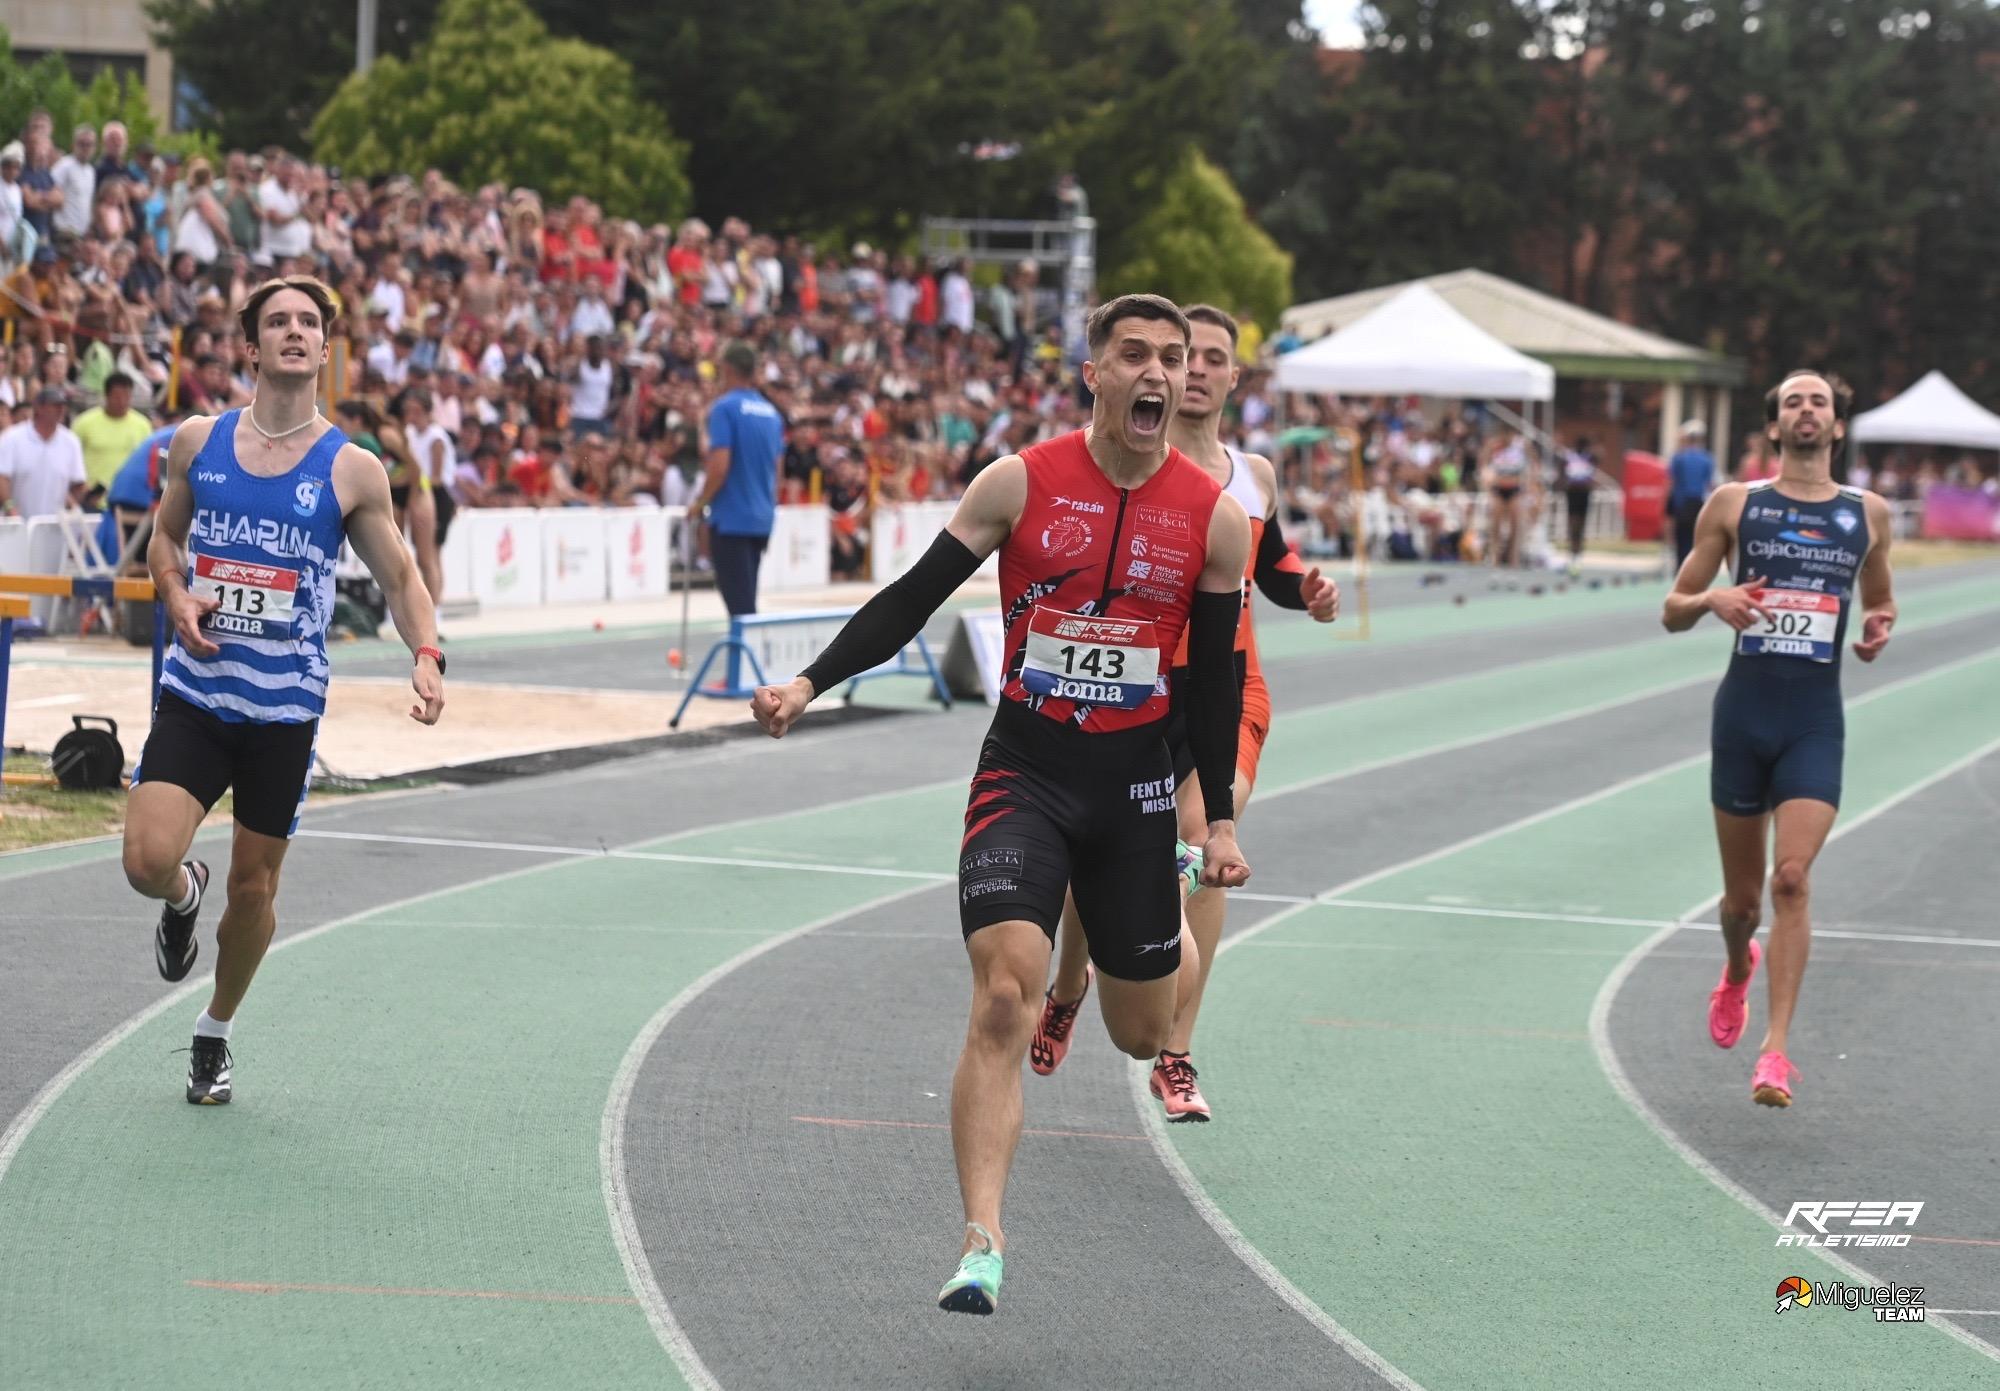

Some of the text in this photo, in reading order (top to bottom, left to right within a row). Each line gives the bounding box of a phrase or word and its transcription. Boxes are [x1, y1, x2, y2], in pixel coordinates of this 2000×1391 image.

[198, 470, 226, 484] vive
[197, 509, 311, 558] CHAPIN
[1151, 544, 1189, 558] Ajuntament
[1747, 539, 1858, 566] CajaCanarias
[1154, 565, 1184, 576] MISLATA
[214, 585, 265, 615] 113
[1084, 622, 1140, 636] RFEA
[1080, 633, 1133, 643] ATLETISMO
[1060, 645, 1125, 679] 143
[1050, 678, 1124, 703] Joma
[1130, 780, 1161, 800] FENT
[968, 879, 1012, 893] COMUNITAT
